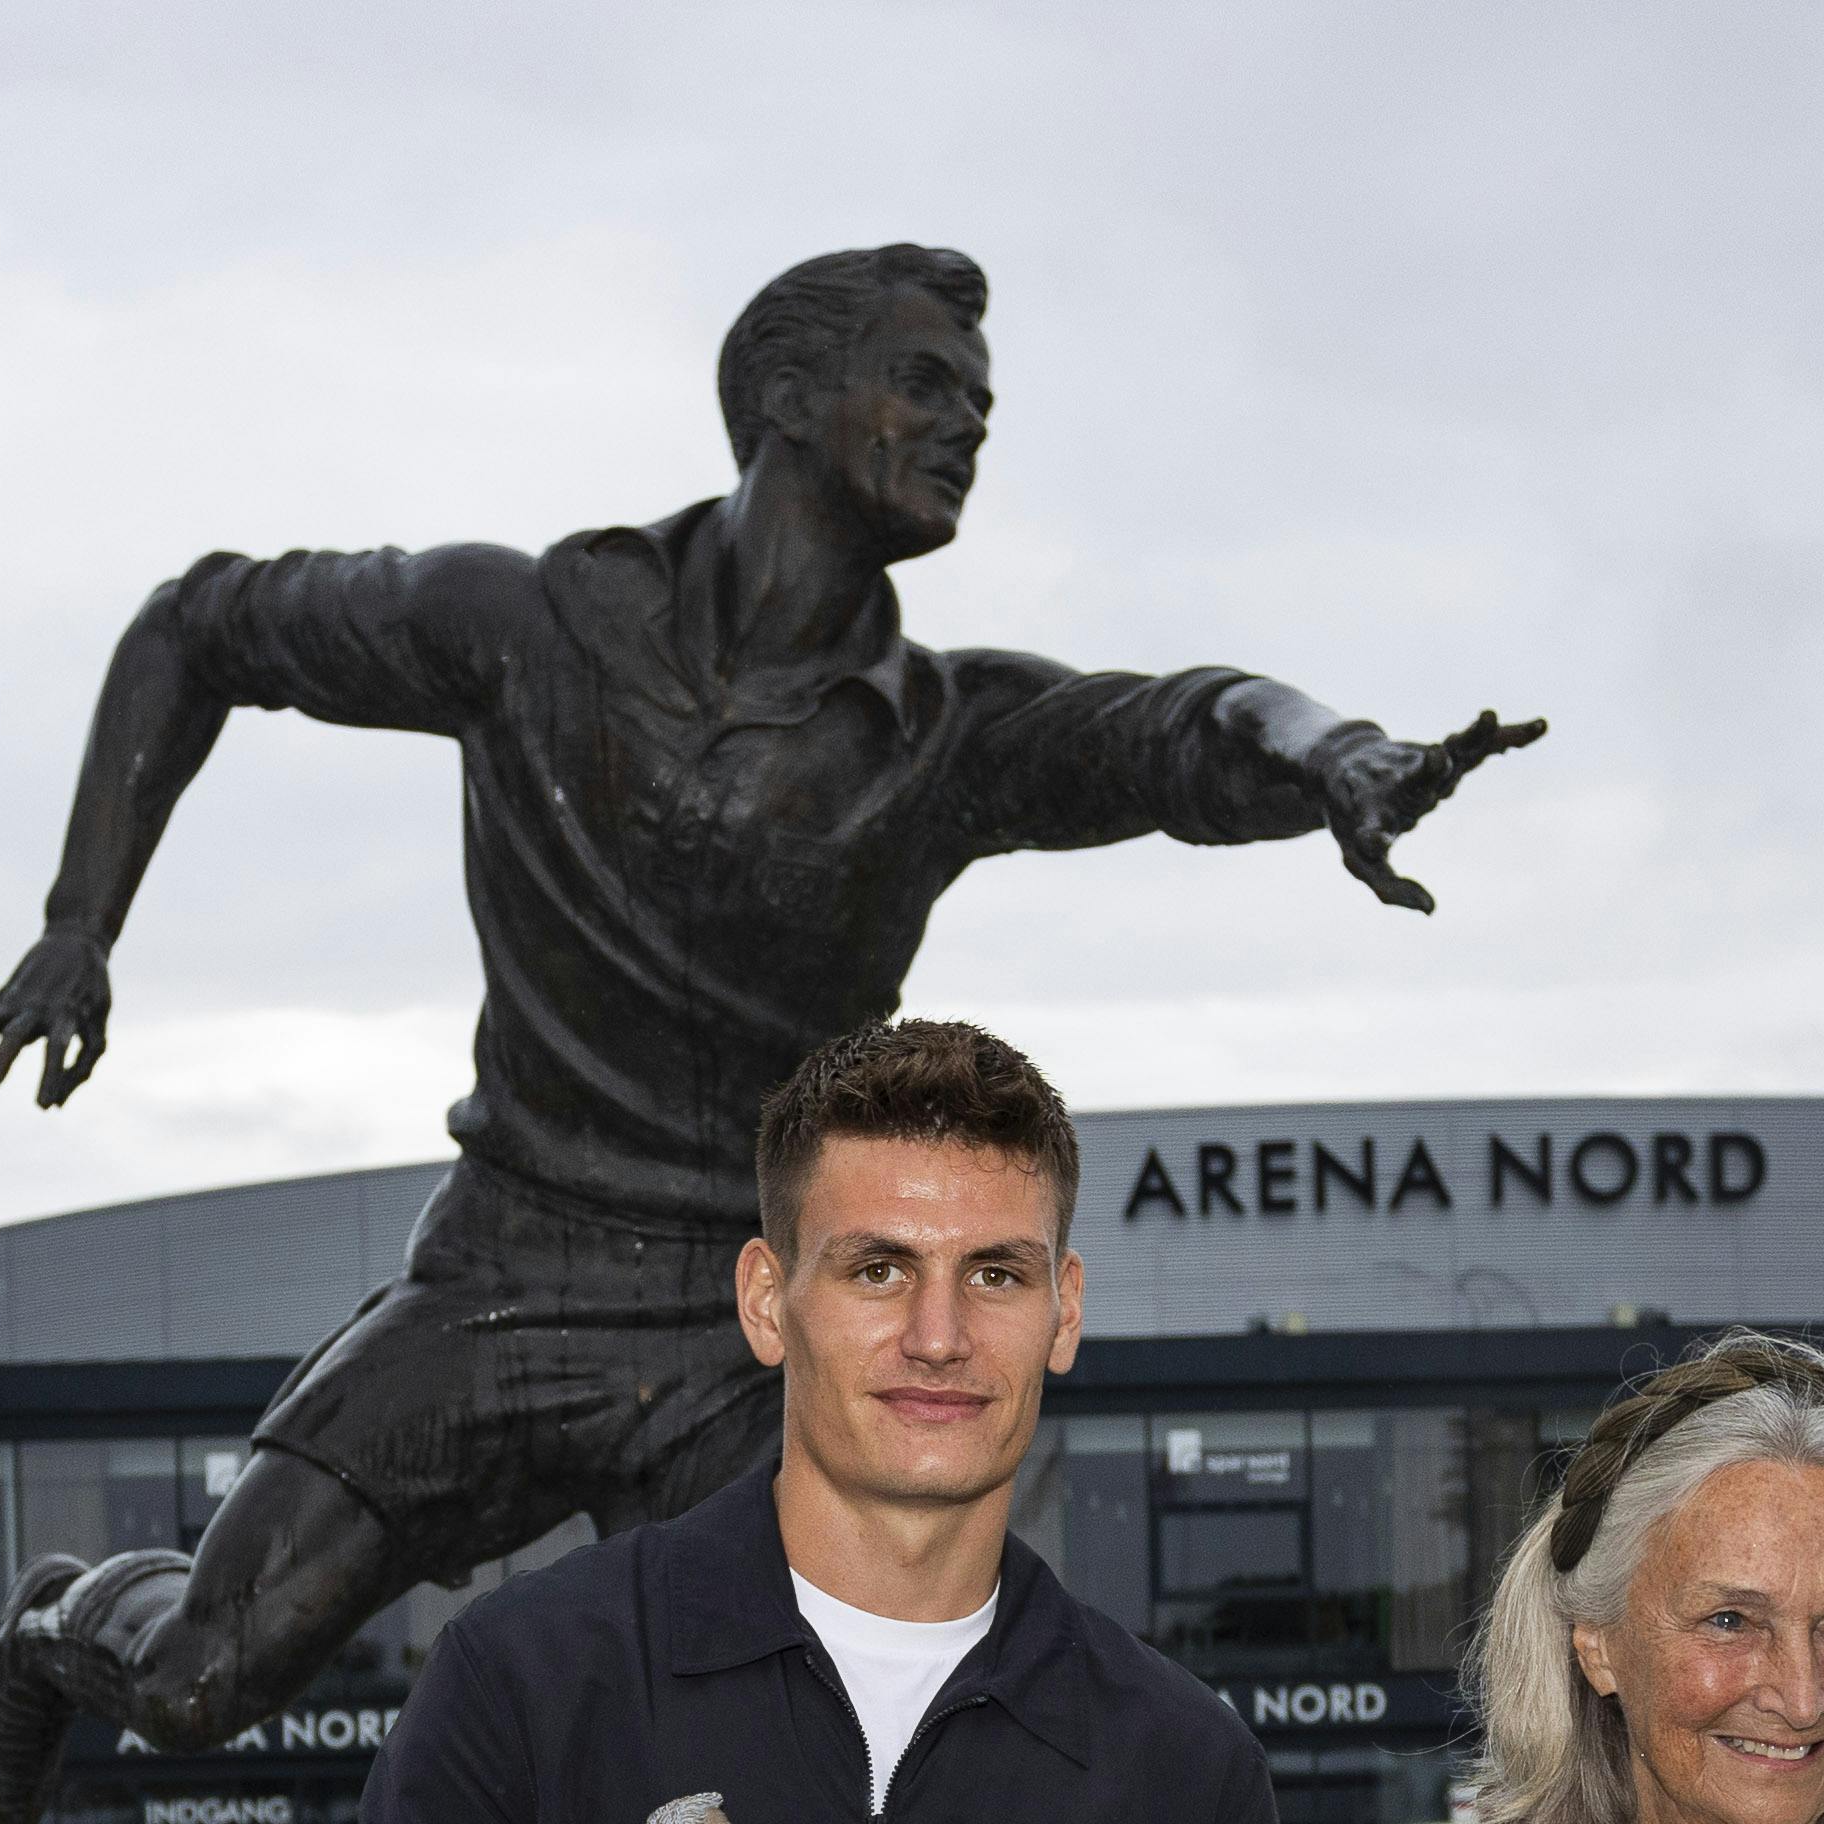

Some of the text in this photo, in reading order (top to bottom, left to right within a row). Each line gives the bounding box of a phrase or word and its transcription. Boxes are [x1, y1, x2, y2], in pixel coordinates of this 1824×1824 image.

[1124, 1131, 1768, 1221] ARENA NORD
[1253, 1683, 1388, 1724] NORD
